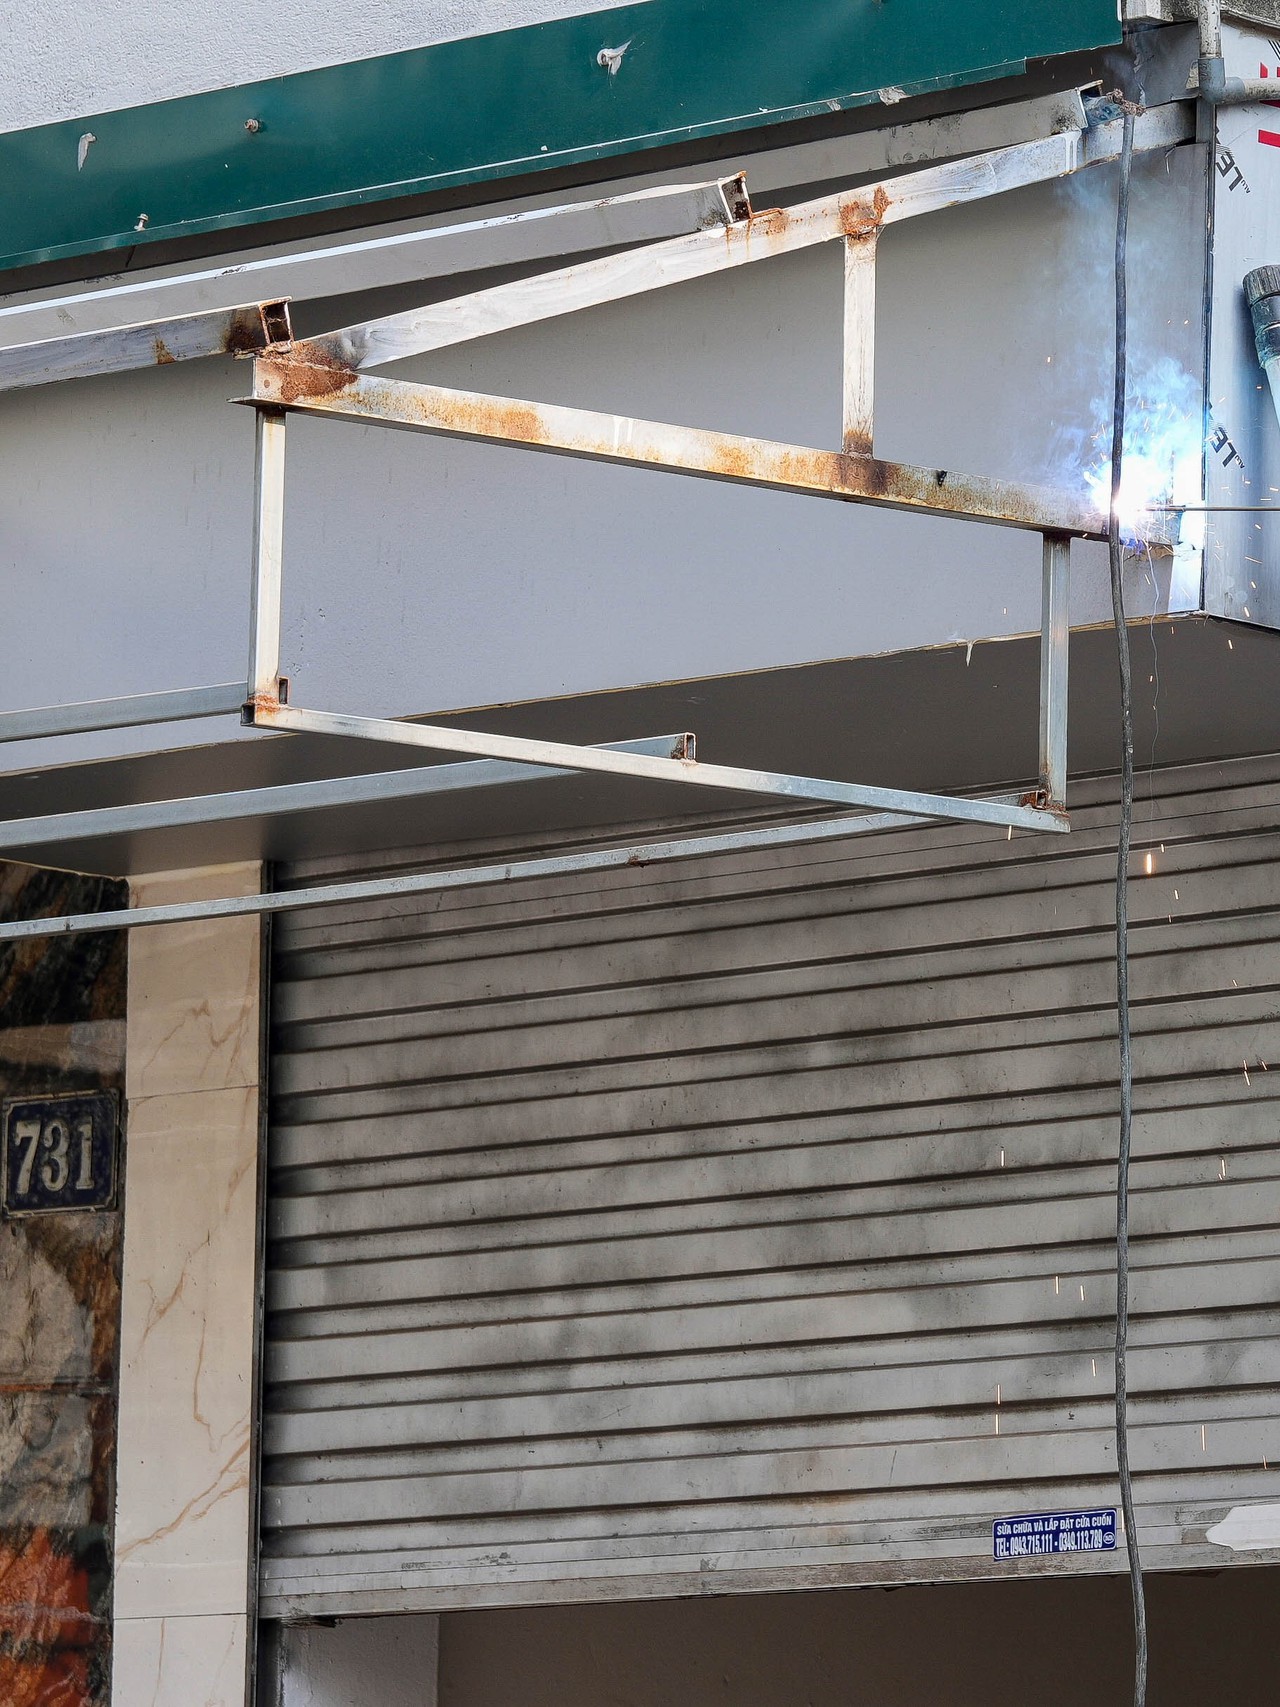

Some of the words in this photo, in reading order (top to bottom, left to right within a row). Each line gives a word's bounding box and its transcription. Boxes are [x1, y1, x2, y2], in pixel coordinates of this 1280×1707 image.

[14, 1115, 95, 1196] 731
[996, 1523, 1011, 1535] SỬA
[1013, 1521, 1032, 1534] CHỮA
[1034, 1519, 1043, 1532] VÀ
[1075, 1515, 1090, 1528] CỬA
[1092, 1512, 1112, 1527] CUỐN
[996, 1537, 1010, 1557] TEL:
